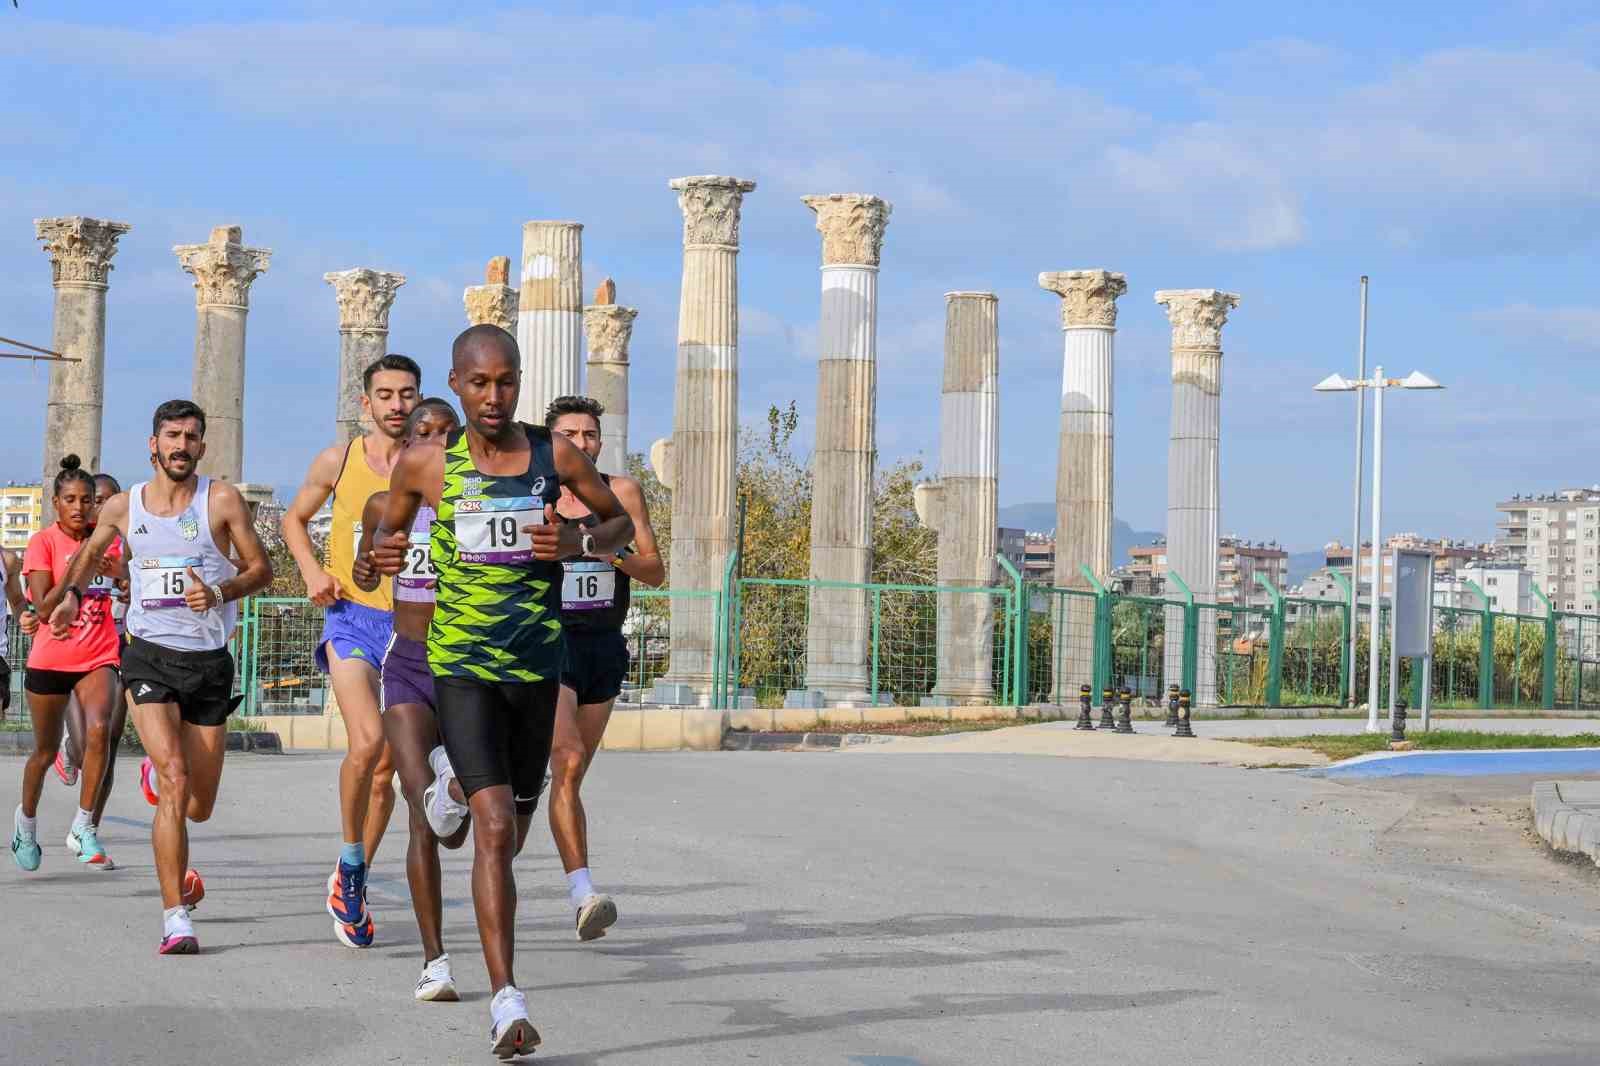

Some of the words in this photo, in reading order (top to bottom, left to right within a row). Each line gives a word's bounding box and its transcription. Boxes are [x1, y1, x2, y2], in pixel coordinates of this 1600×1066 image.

[461, 501, 481, 510] 42K
[486, 517, 516, 547] 19
[161, 572, 184, 594] 15
[575, 576, 598, 598] 16
